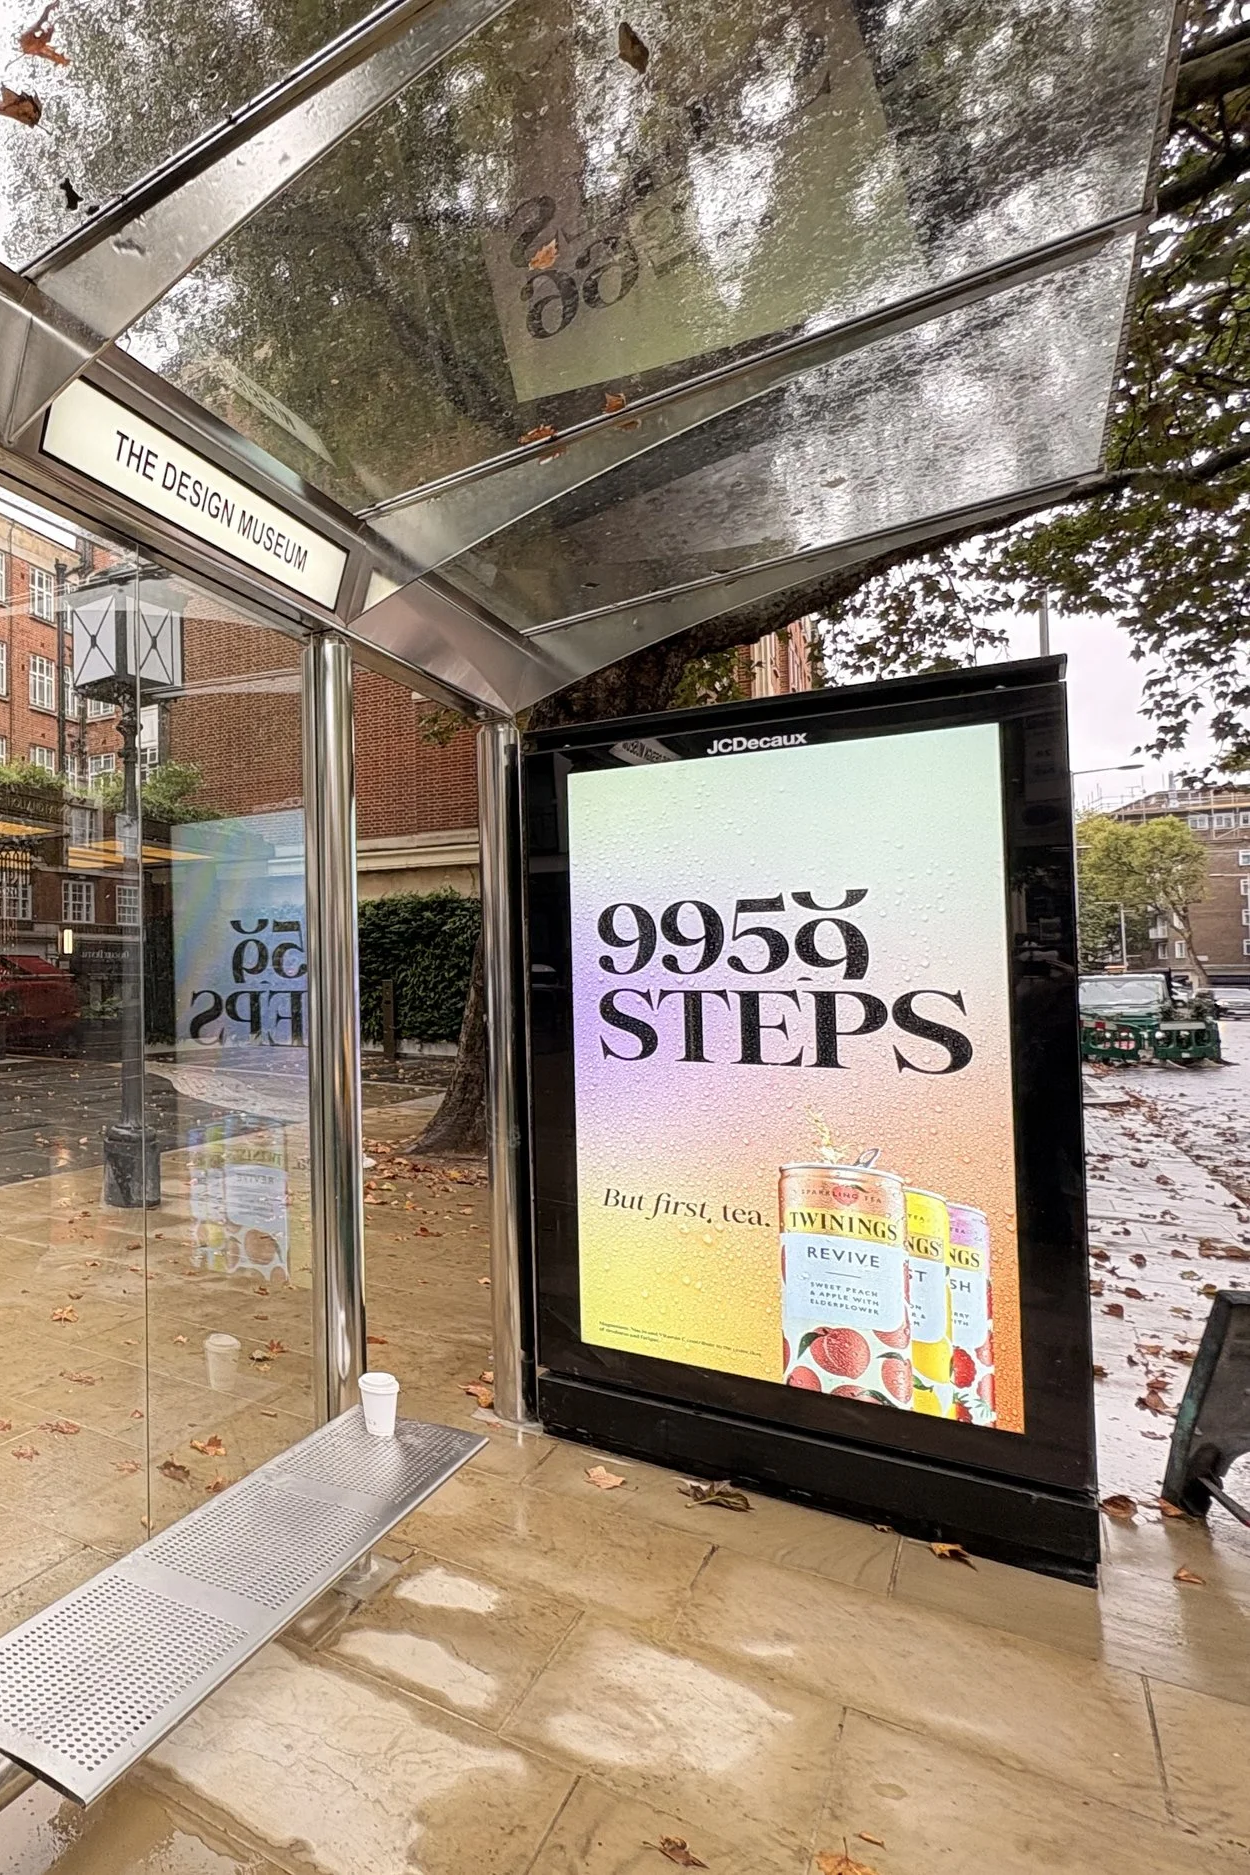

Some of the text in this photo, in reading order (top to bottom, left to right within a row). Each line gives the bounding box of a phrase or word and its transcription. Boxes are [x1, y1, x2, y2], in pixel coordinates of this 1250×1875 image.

[115, 430, 308, 573] THE DESIGN MUSEUM
[707, 732, 808, 755] JCDecaux
[598, 986, 974, 1076] STEPS
[801, 1188, 882, 1204] SPARKLING TEA
[602, 1187, 645, 1211] But
[722, 1202, 772, 1229] tea.
[789, 1211, 898, 1241] TWININGS
[807, 1246, 880, 1268] REVIVE
[810, 1281, 878, 1298] SWEET PEACH
[818, 1291, 850, 1301] APPLE
[852, 1296, 879, 1306] WITH
[810, 1298, 879, 1316] ELDERFLOWER
